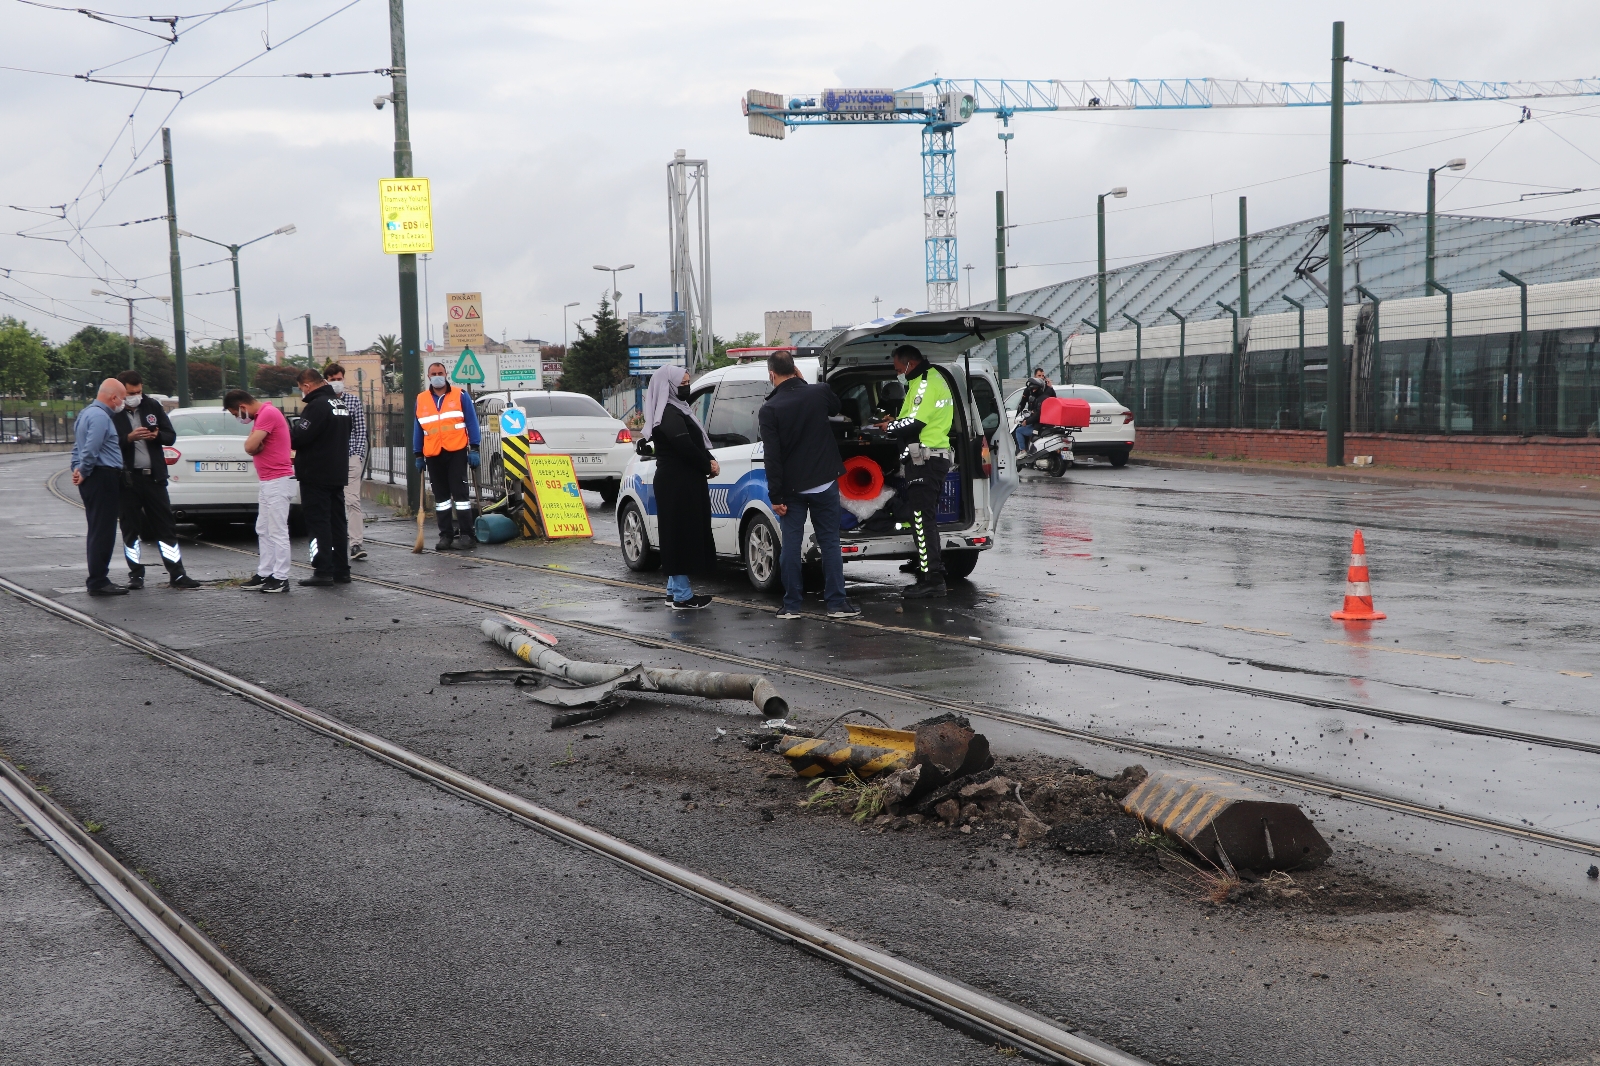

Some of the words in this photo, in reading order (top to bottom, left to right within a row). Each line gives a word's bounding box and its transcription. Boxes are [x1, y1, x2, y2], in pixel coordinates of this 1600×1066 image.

[838, 93, 893, 104] BÜYÜKŞEHİR
[845, 113, 875, 121] KULE
[386, 184, 422, 192] DİKKAT
[384, 195, 407, 203] Tramvay
[403, 220, 418, 229] EDS
[387, 241, 430, 249] Kesilmektedir
[461, 364, 476, 376] 40
[201, 462, 209, 471] 01
[215, 462, 229, 471] CYU
[237, 462, 246, 471] 29
[545, 480, 562, 489] EDS
[564, 502, 583, 510] Girmek
[545, 512, 564, 520] Yoluna
[563, 511, 586, 520] Tramvay
[553, 523, 585, 532] DİKKAT
